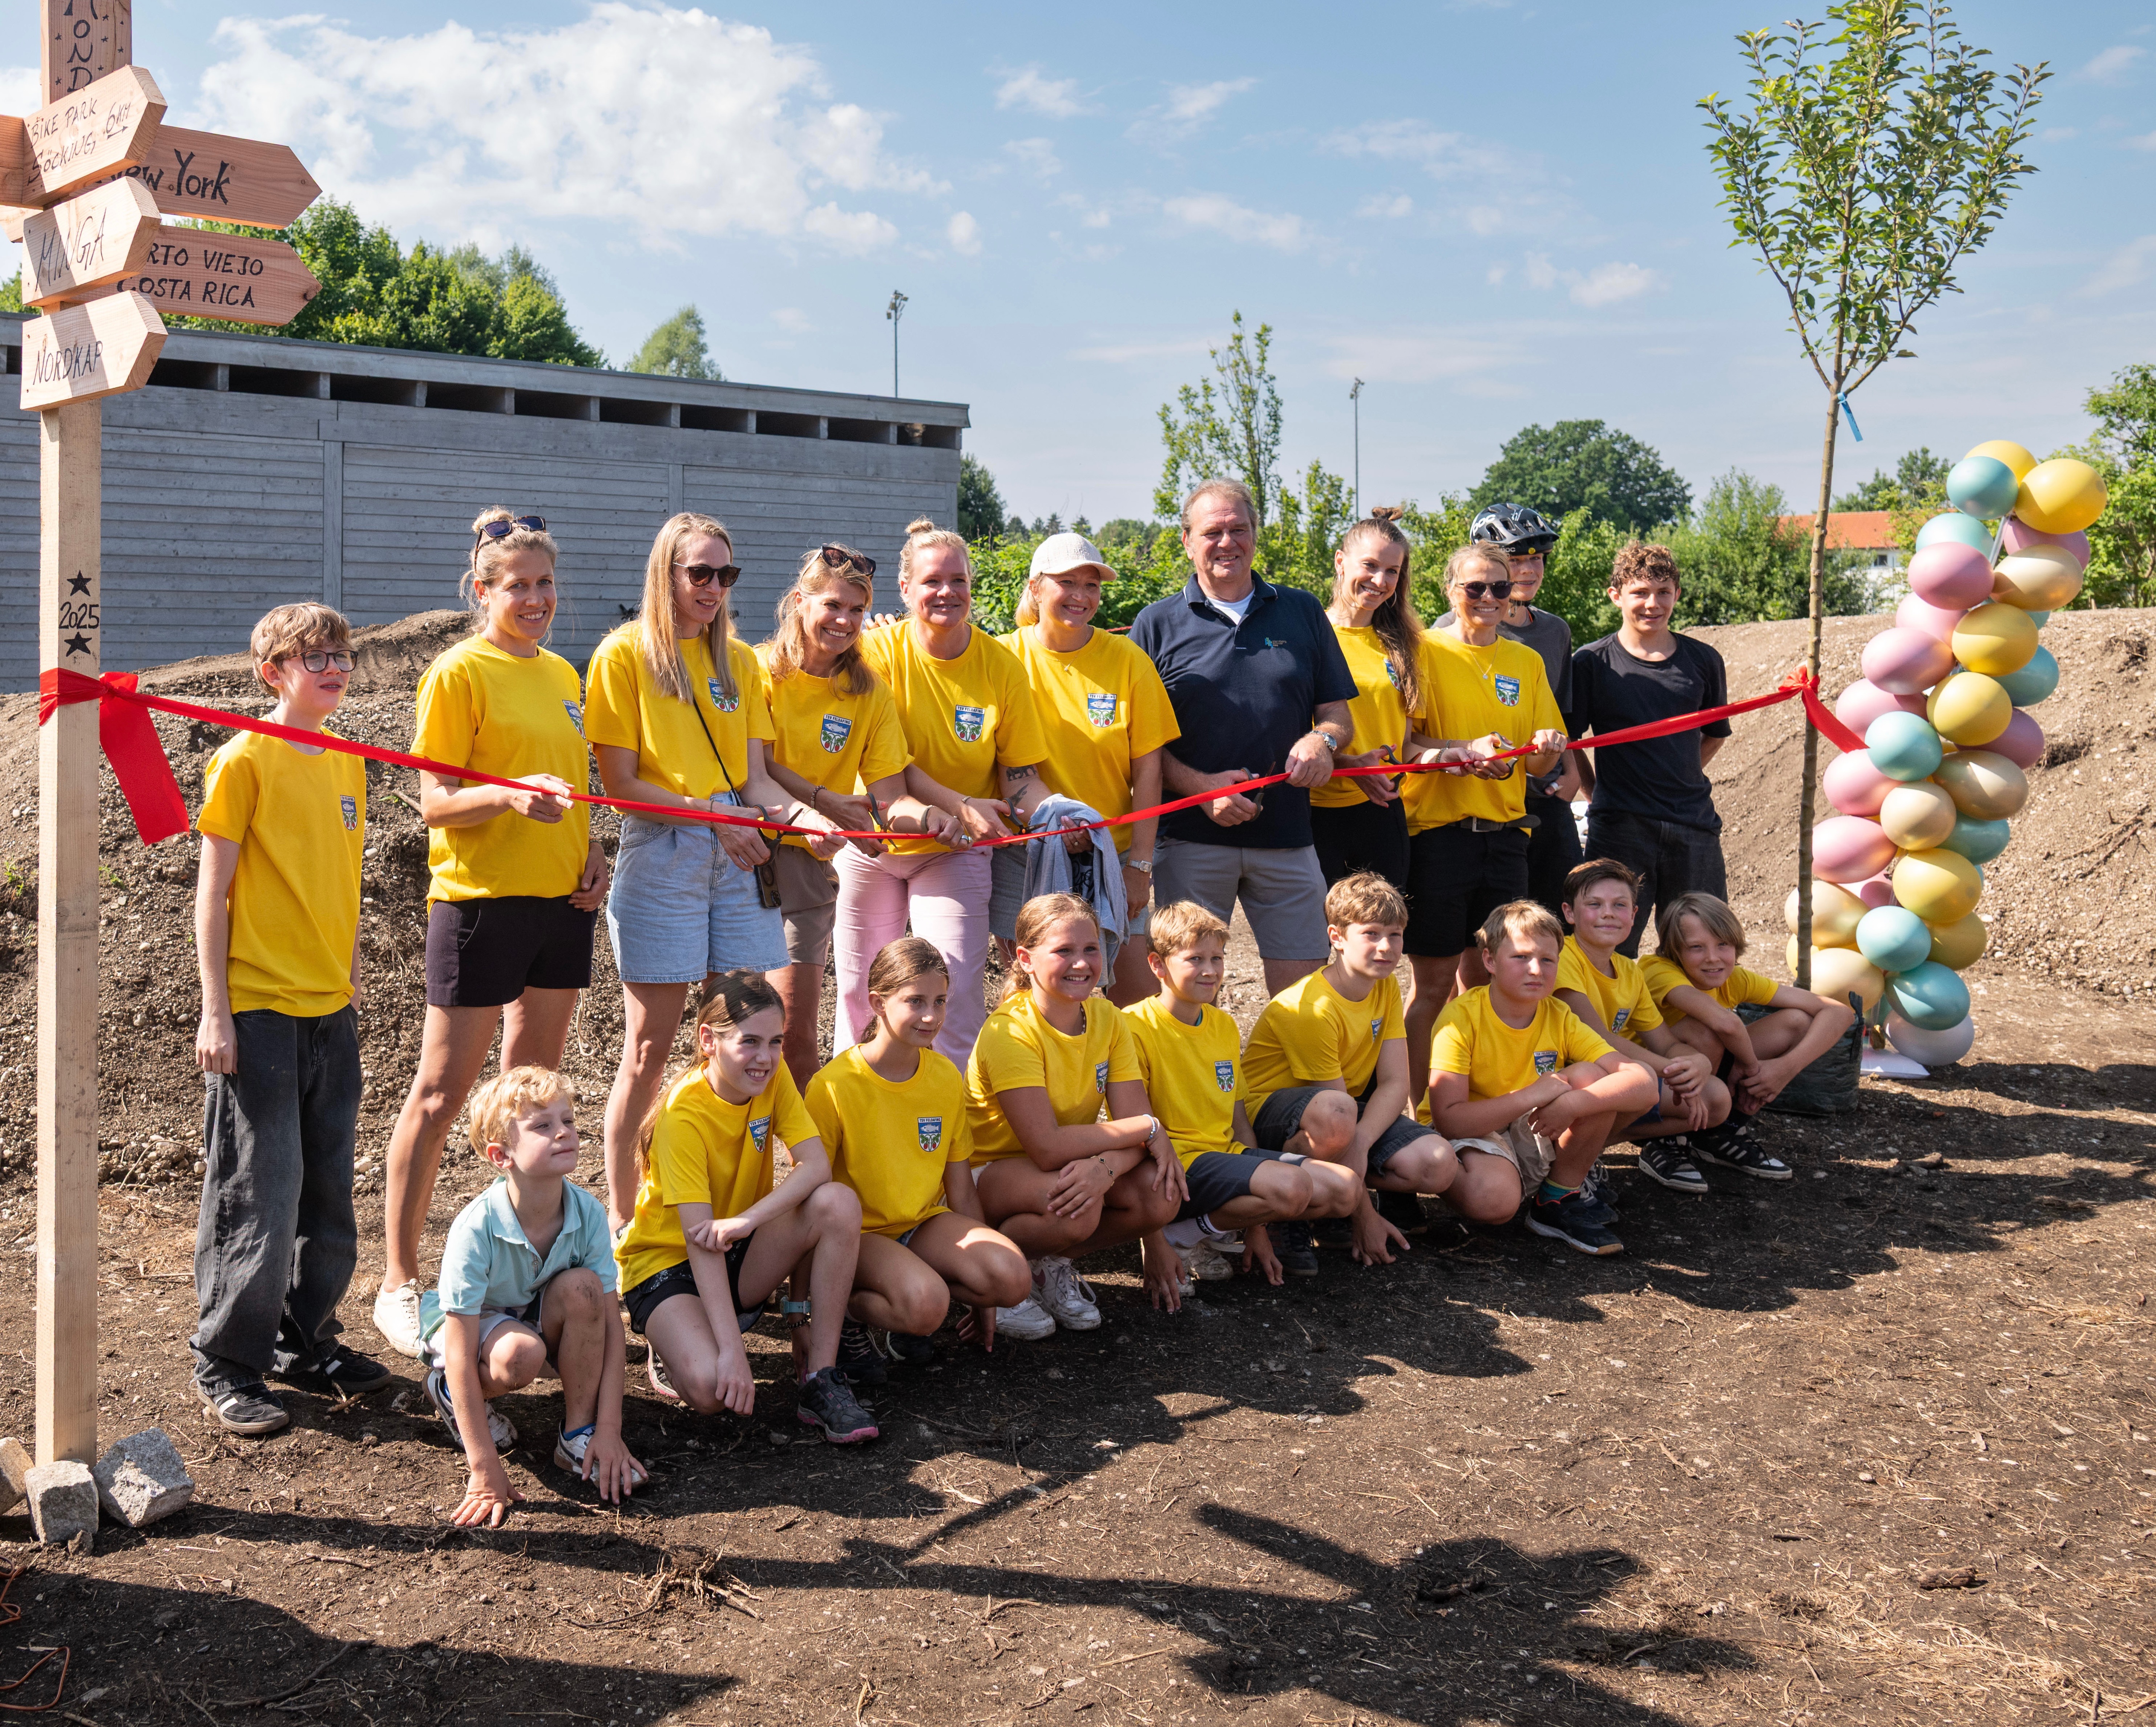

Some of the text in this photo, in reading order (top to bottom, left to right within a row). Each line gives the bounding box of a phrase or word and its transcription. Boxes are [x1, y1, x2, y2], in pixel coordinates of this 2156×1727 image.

[31, 97, 97, 148] BIKE PARK
[174, 148, 230, 205] York
[35, 207, 107, 292] MINGA
[146, 242, 264, 275] RTO VIEJO
[117, 277, 255, 308] COSTA RICA
[33, 340, 103, 385] NORDKAP
[58, 601, 100, 629] 2025
